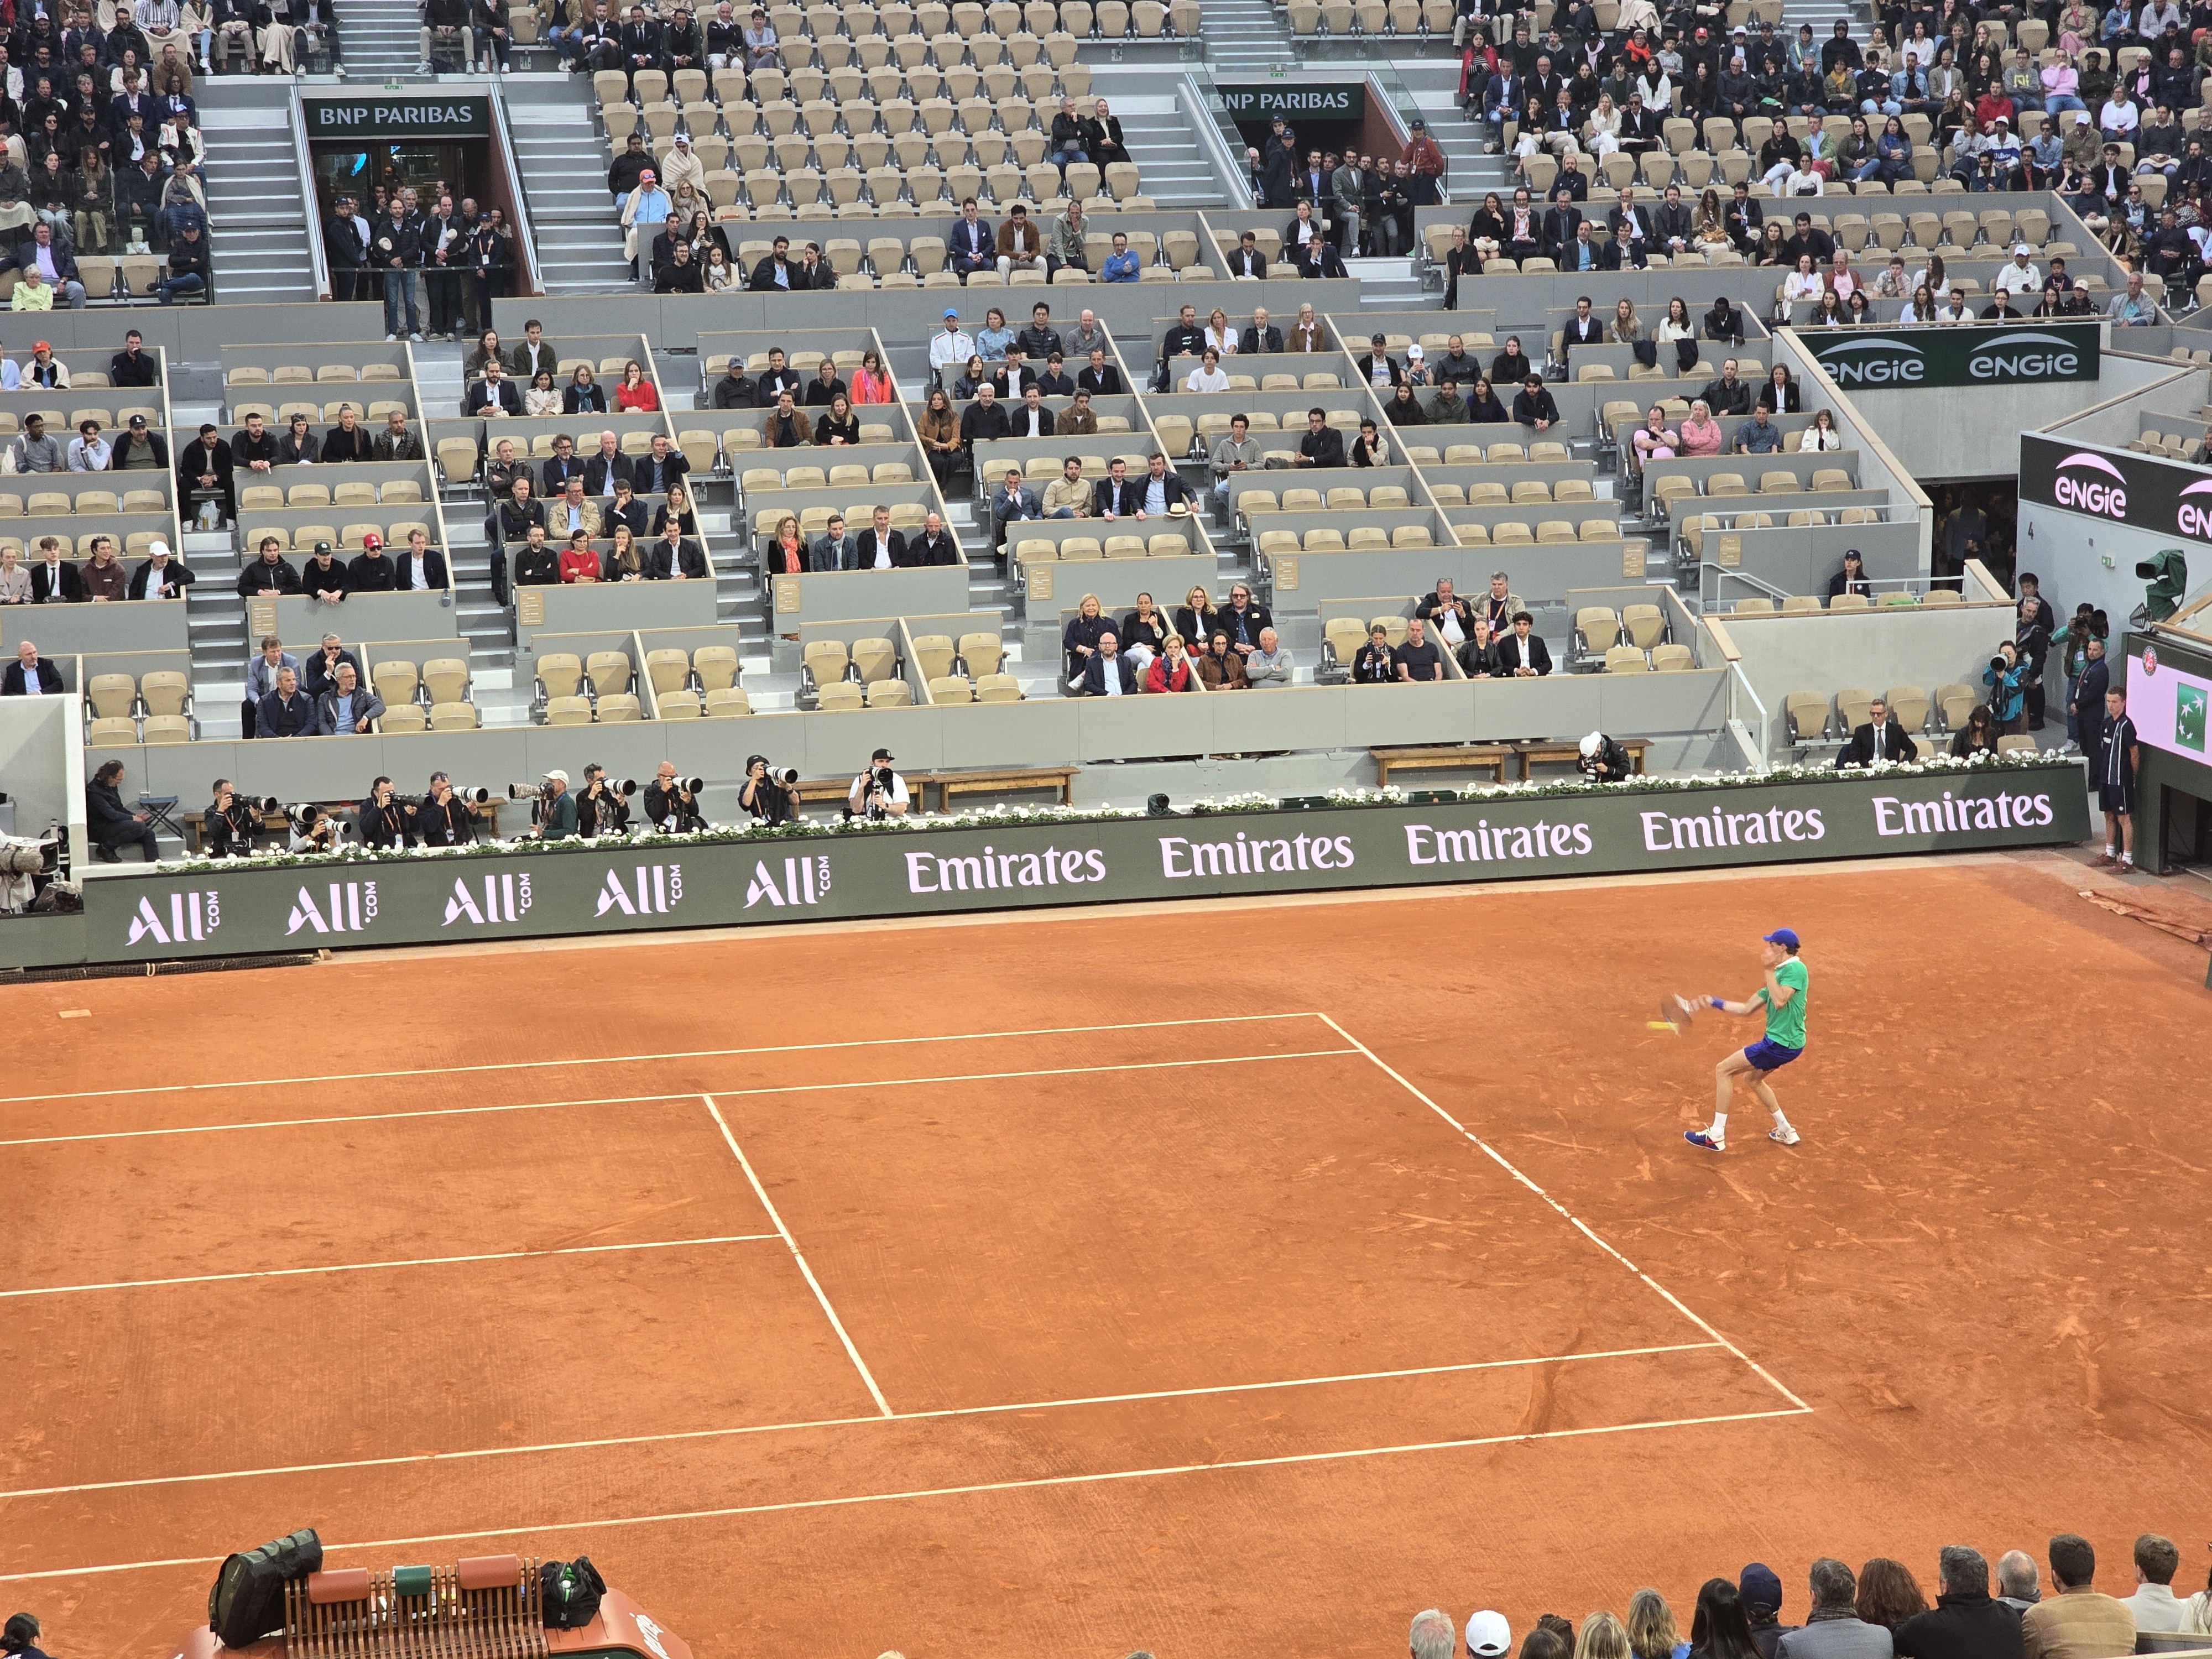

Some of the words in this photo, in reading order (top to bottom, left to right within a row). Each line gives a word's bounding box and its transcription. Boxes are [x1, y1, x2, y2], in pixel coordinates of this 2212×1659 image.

[320, 108, 368, 124] BNP
[374, 106, 473, 124] PARIBAS
[1209, 93, 1254, 109] BNP
[1260, 92, 1349, 109] PARIBAS
[2028, 521, 2034, 540] 4
[1641, 806, 1825, 851] Emirates
[1872, 791, 2053, 836] Emirates
[1159, 832, 1354, 878] Emirates
[1405, 819, 1592, 865] Emirates
[905, 846, 1106, 893] Emirates
